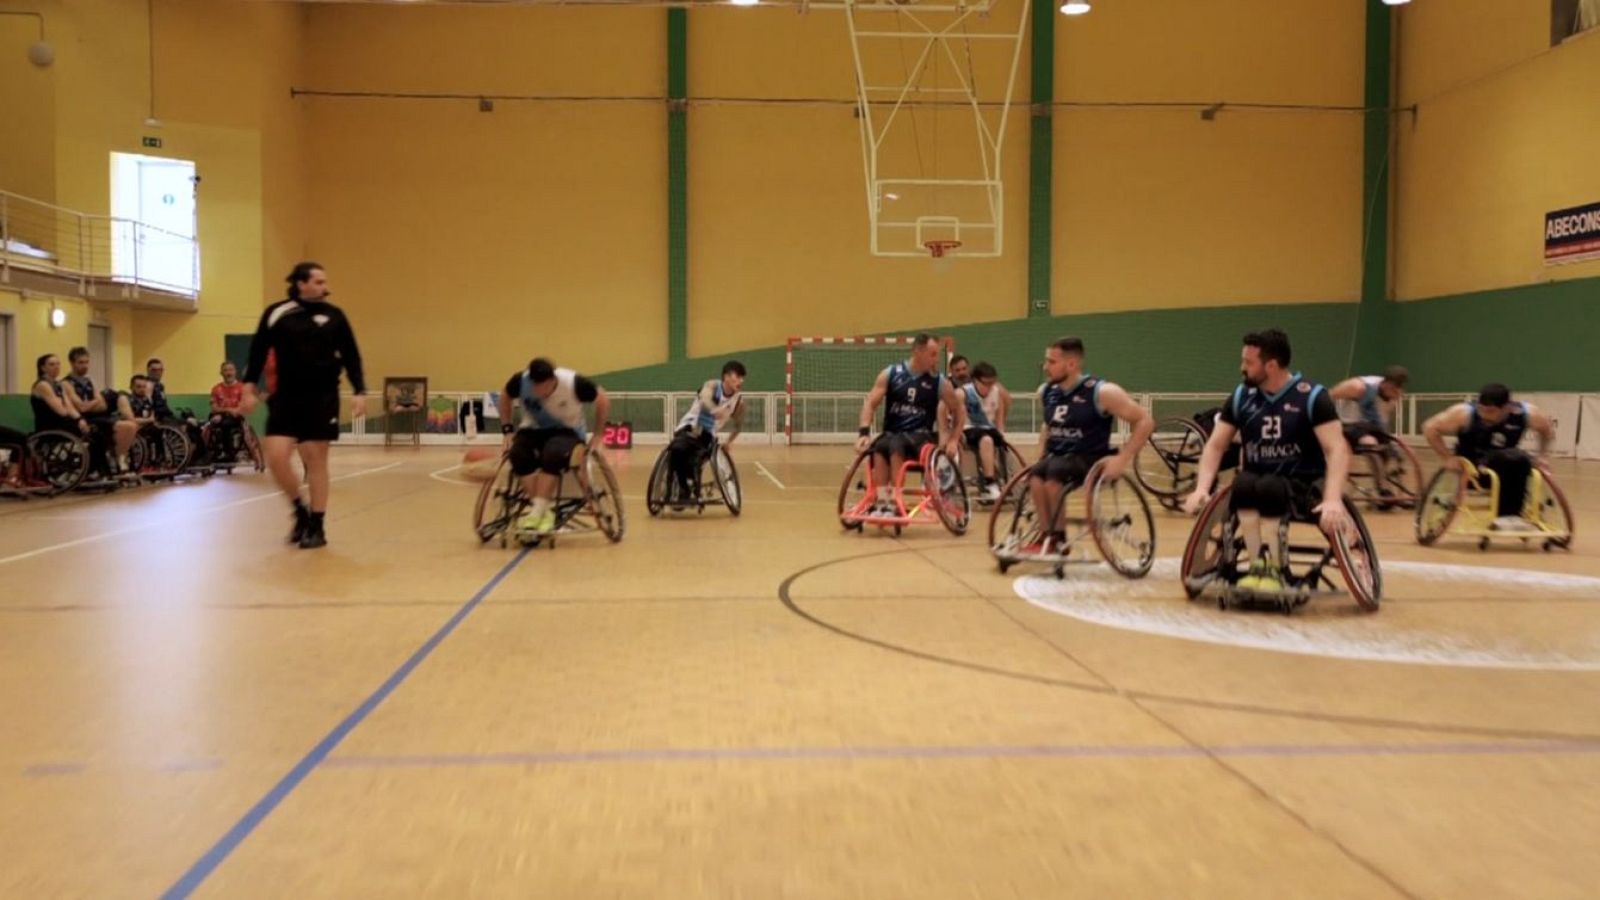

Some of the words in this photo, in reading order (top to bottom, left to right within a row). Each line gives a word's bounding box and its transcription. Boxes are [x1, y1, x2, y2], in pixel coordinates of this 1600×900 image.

[908, 388, 916, 402] 9
[1262, 416, 1282, 439] 23
[603, 428, 629, 444] 20
[1261, 444, 1301, 457] BRAGA
